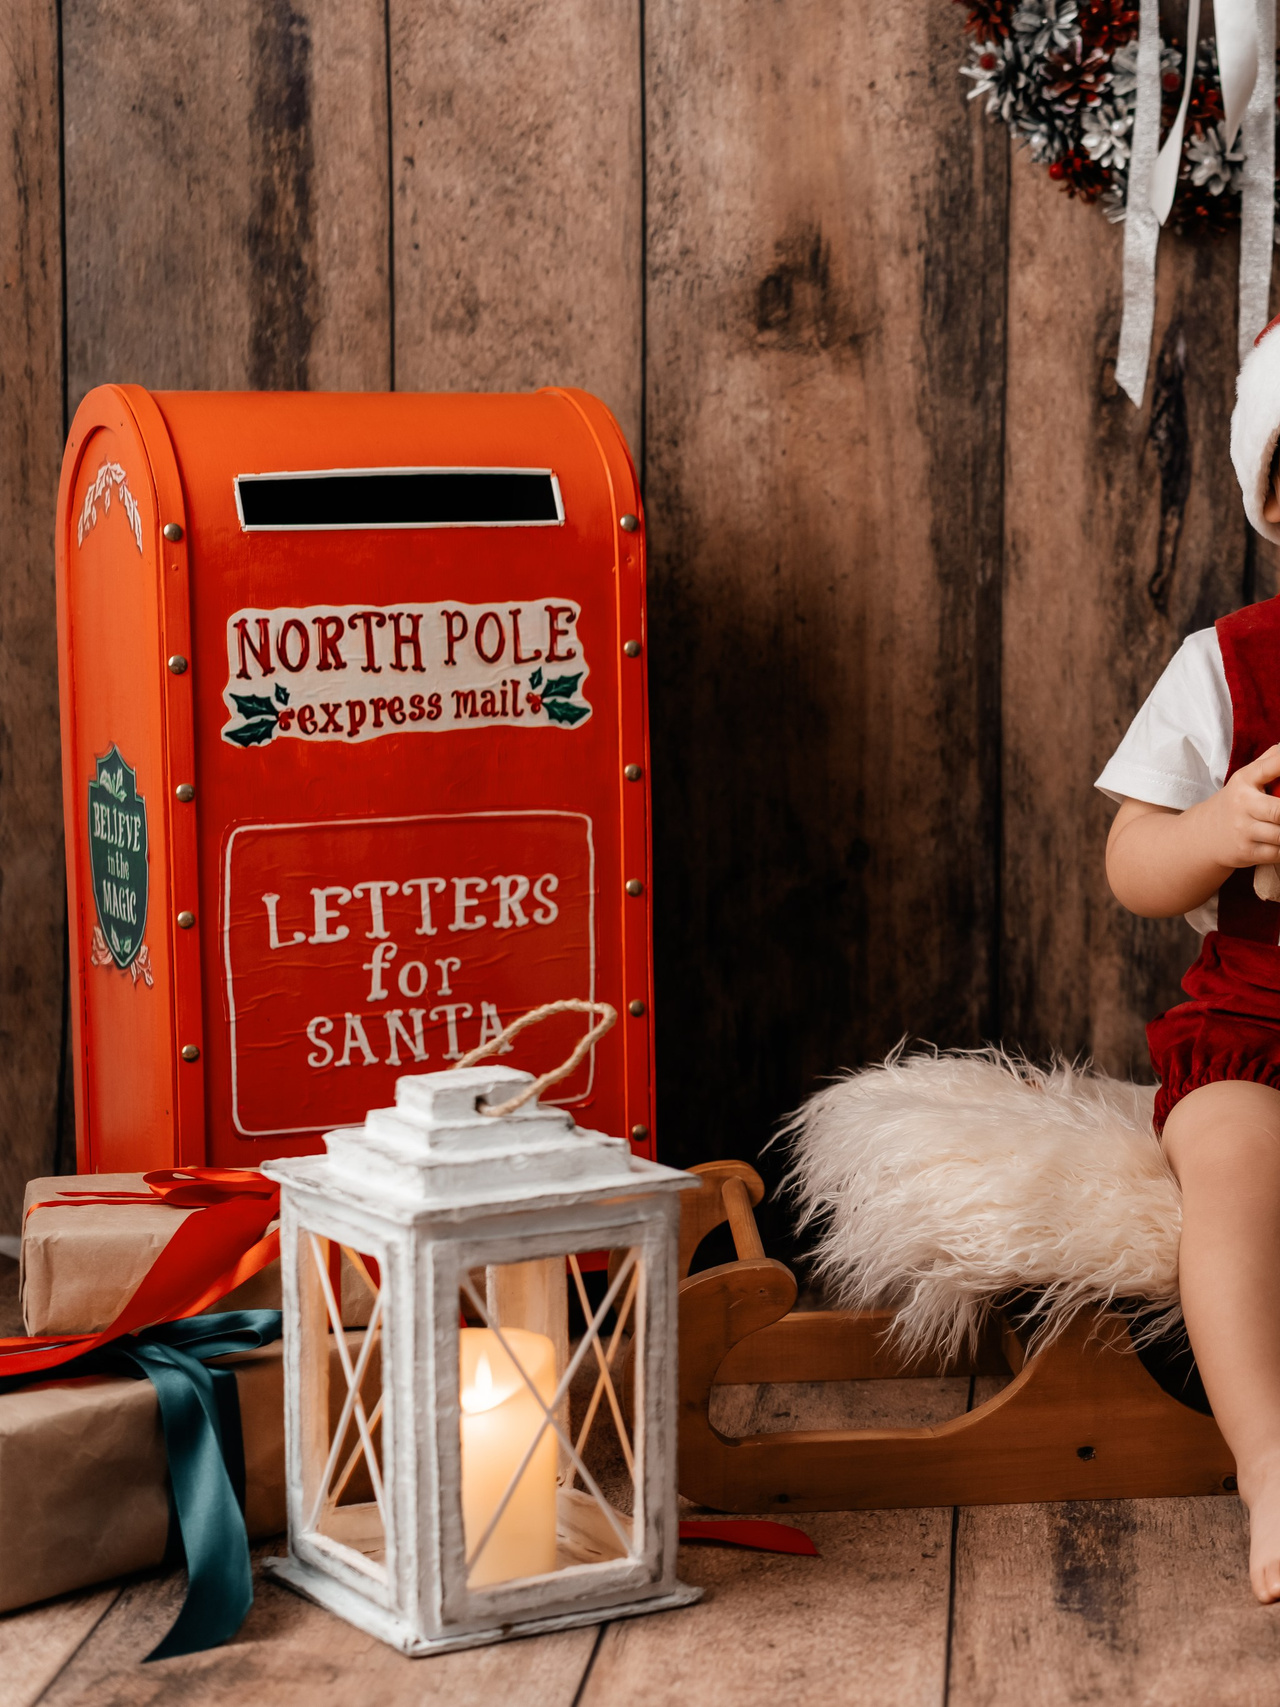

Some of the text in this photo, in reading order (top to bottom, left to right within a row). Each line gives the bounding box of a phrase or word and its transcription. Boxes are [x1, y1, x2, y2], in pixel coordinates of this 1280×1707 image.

[232, 604, 577, 681] NORTH POLE
[294, 678, 525, 738] express mail
[92, 800, 142, 853] BELIEVE
[102, 878, 137, 926] MAGIC
[261, 872, 560, 950] LETTERS
[362, 941, 462, 1003] for
[306, 1000, 515, 1068] SANTA
